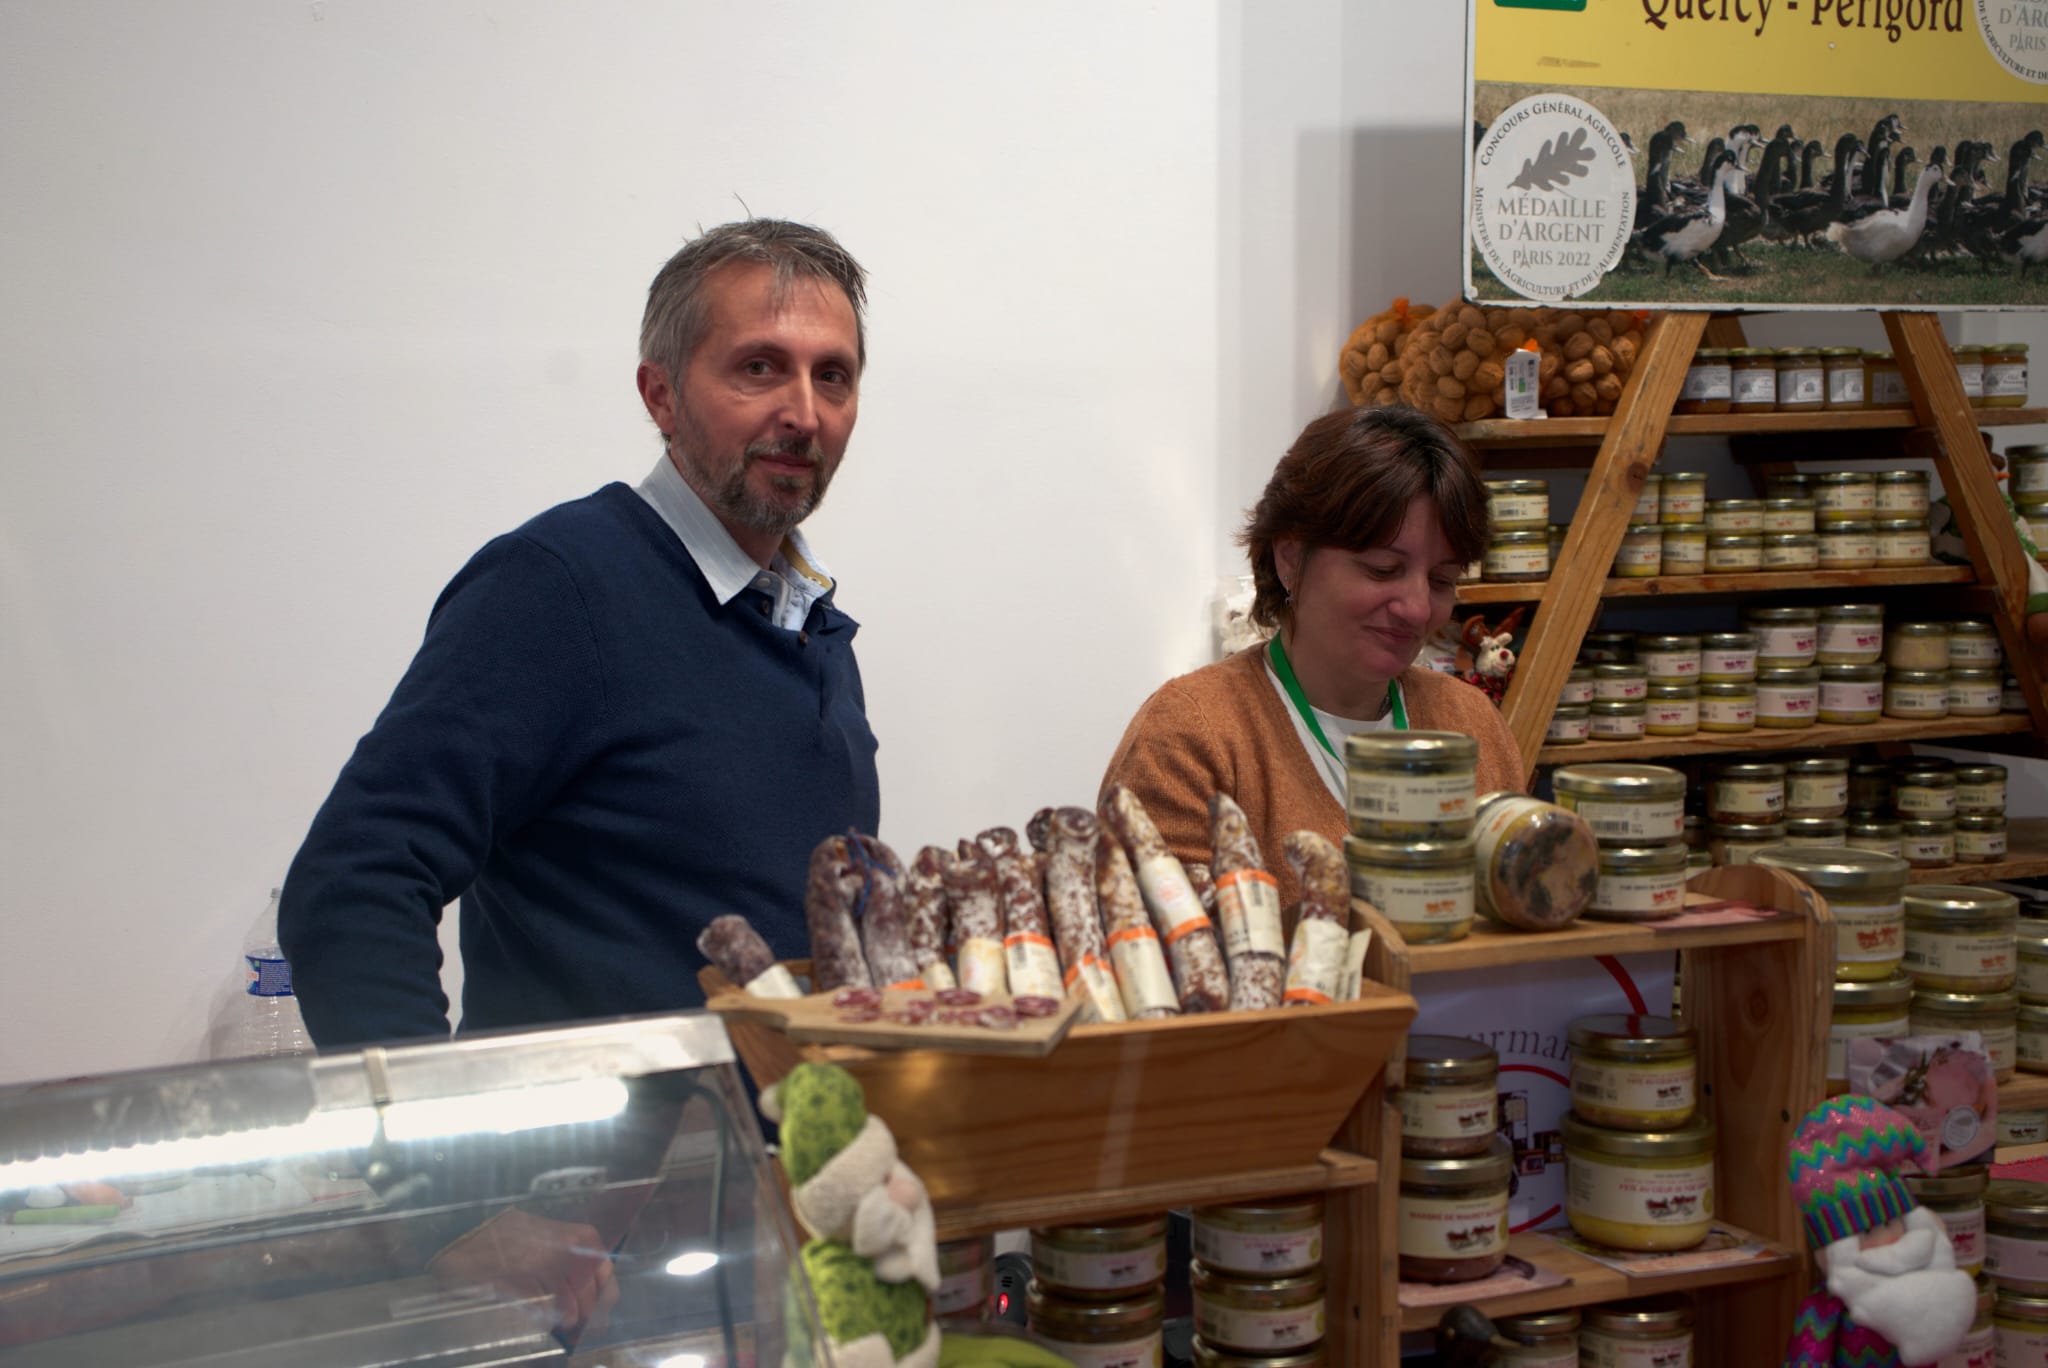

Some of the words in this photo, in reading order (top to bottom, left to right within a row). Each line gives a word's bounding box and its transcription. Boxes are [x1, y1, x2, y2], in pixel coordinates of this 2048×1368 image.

[1641, 0, 1773, 37] Quercy
[2010, 28, 2047, 53] PARIS
[1481, 107, 1530, 166] CONCOURS
[1532, 100, 1584, 120] GÉNÉRAL
[1584, 114, 1626, 168] AGRICOLE
[1497, 192, 1606, 219] MÉDAILLE
[1488, 247, 1502, 262] DE
[1498, 260, 1568, 296] L'AGRICULTURE
[1569, 281, 1581, 294] ET
[1582, 273, 1595, 288] DE
[1594, 191, 1630, 278] L'ALIMENTATION
[1499, 218, 1605, 243] D'ARGENT
[1512, 243, 1553, 269] PARIS
[1557, 251, 1591, 266] 2022
